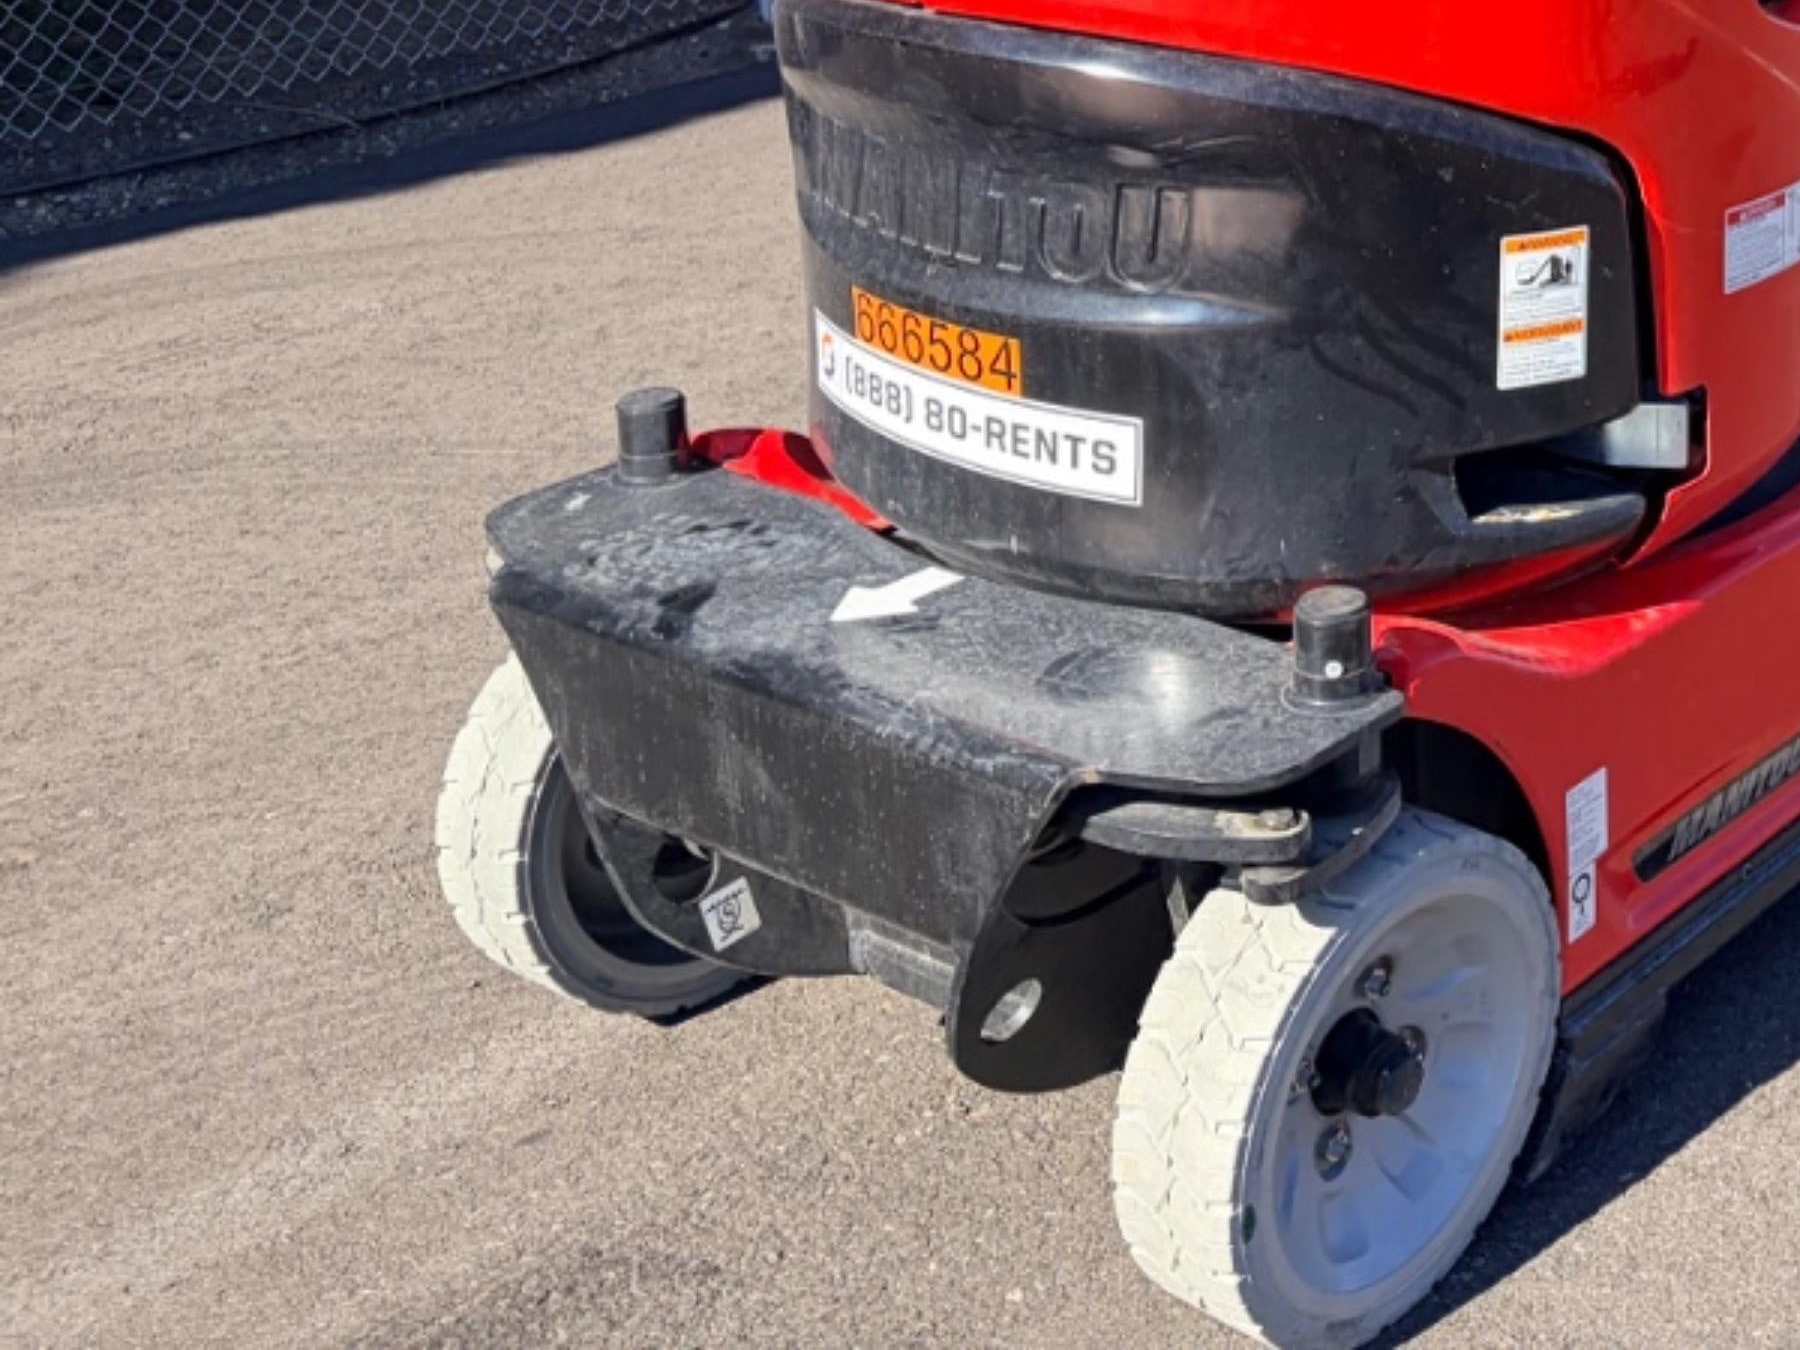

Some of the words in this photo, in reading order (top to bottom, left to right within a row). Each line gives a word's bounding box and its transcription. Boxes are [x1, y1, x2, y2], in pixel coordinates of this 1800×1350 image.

[856, 298, 1018, 390] 666584
[845, 356, 913, 424] (888)
[924, 400, 1118, 476] 80-RENTS
